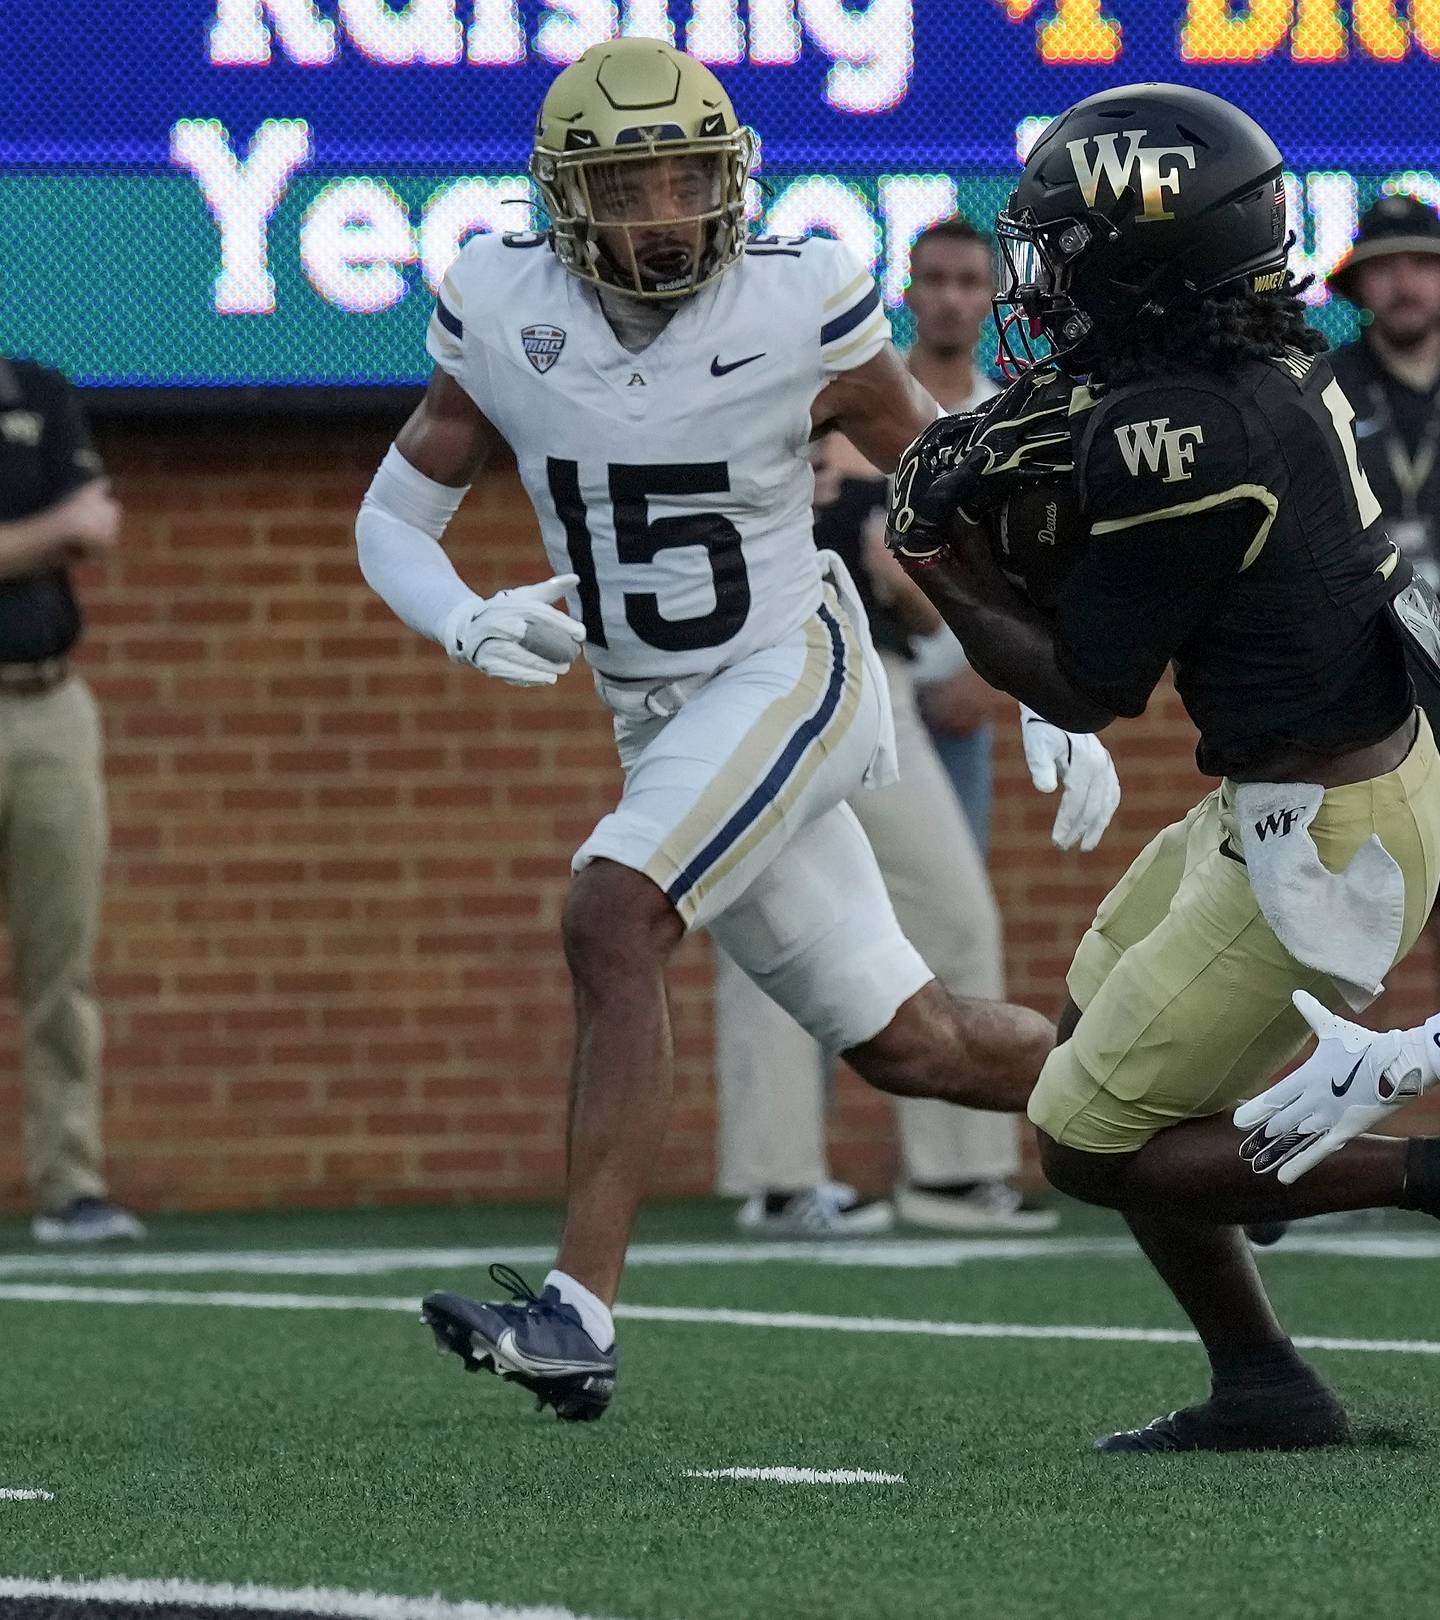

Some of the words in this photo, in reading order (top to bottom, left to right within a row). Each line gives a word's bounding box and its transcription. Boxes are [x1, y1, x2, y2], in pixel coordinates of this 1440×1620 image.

[1066, 129, 1197, 223] WF
[1114, 418, 1204, 483] WF
[546, 457, 752, 652] 15
[1037, 501, 1058, 546] Deacs
[1255, 806, 1307, 842] WF
